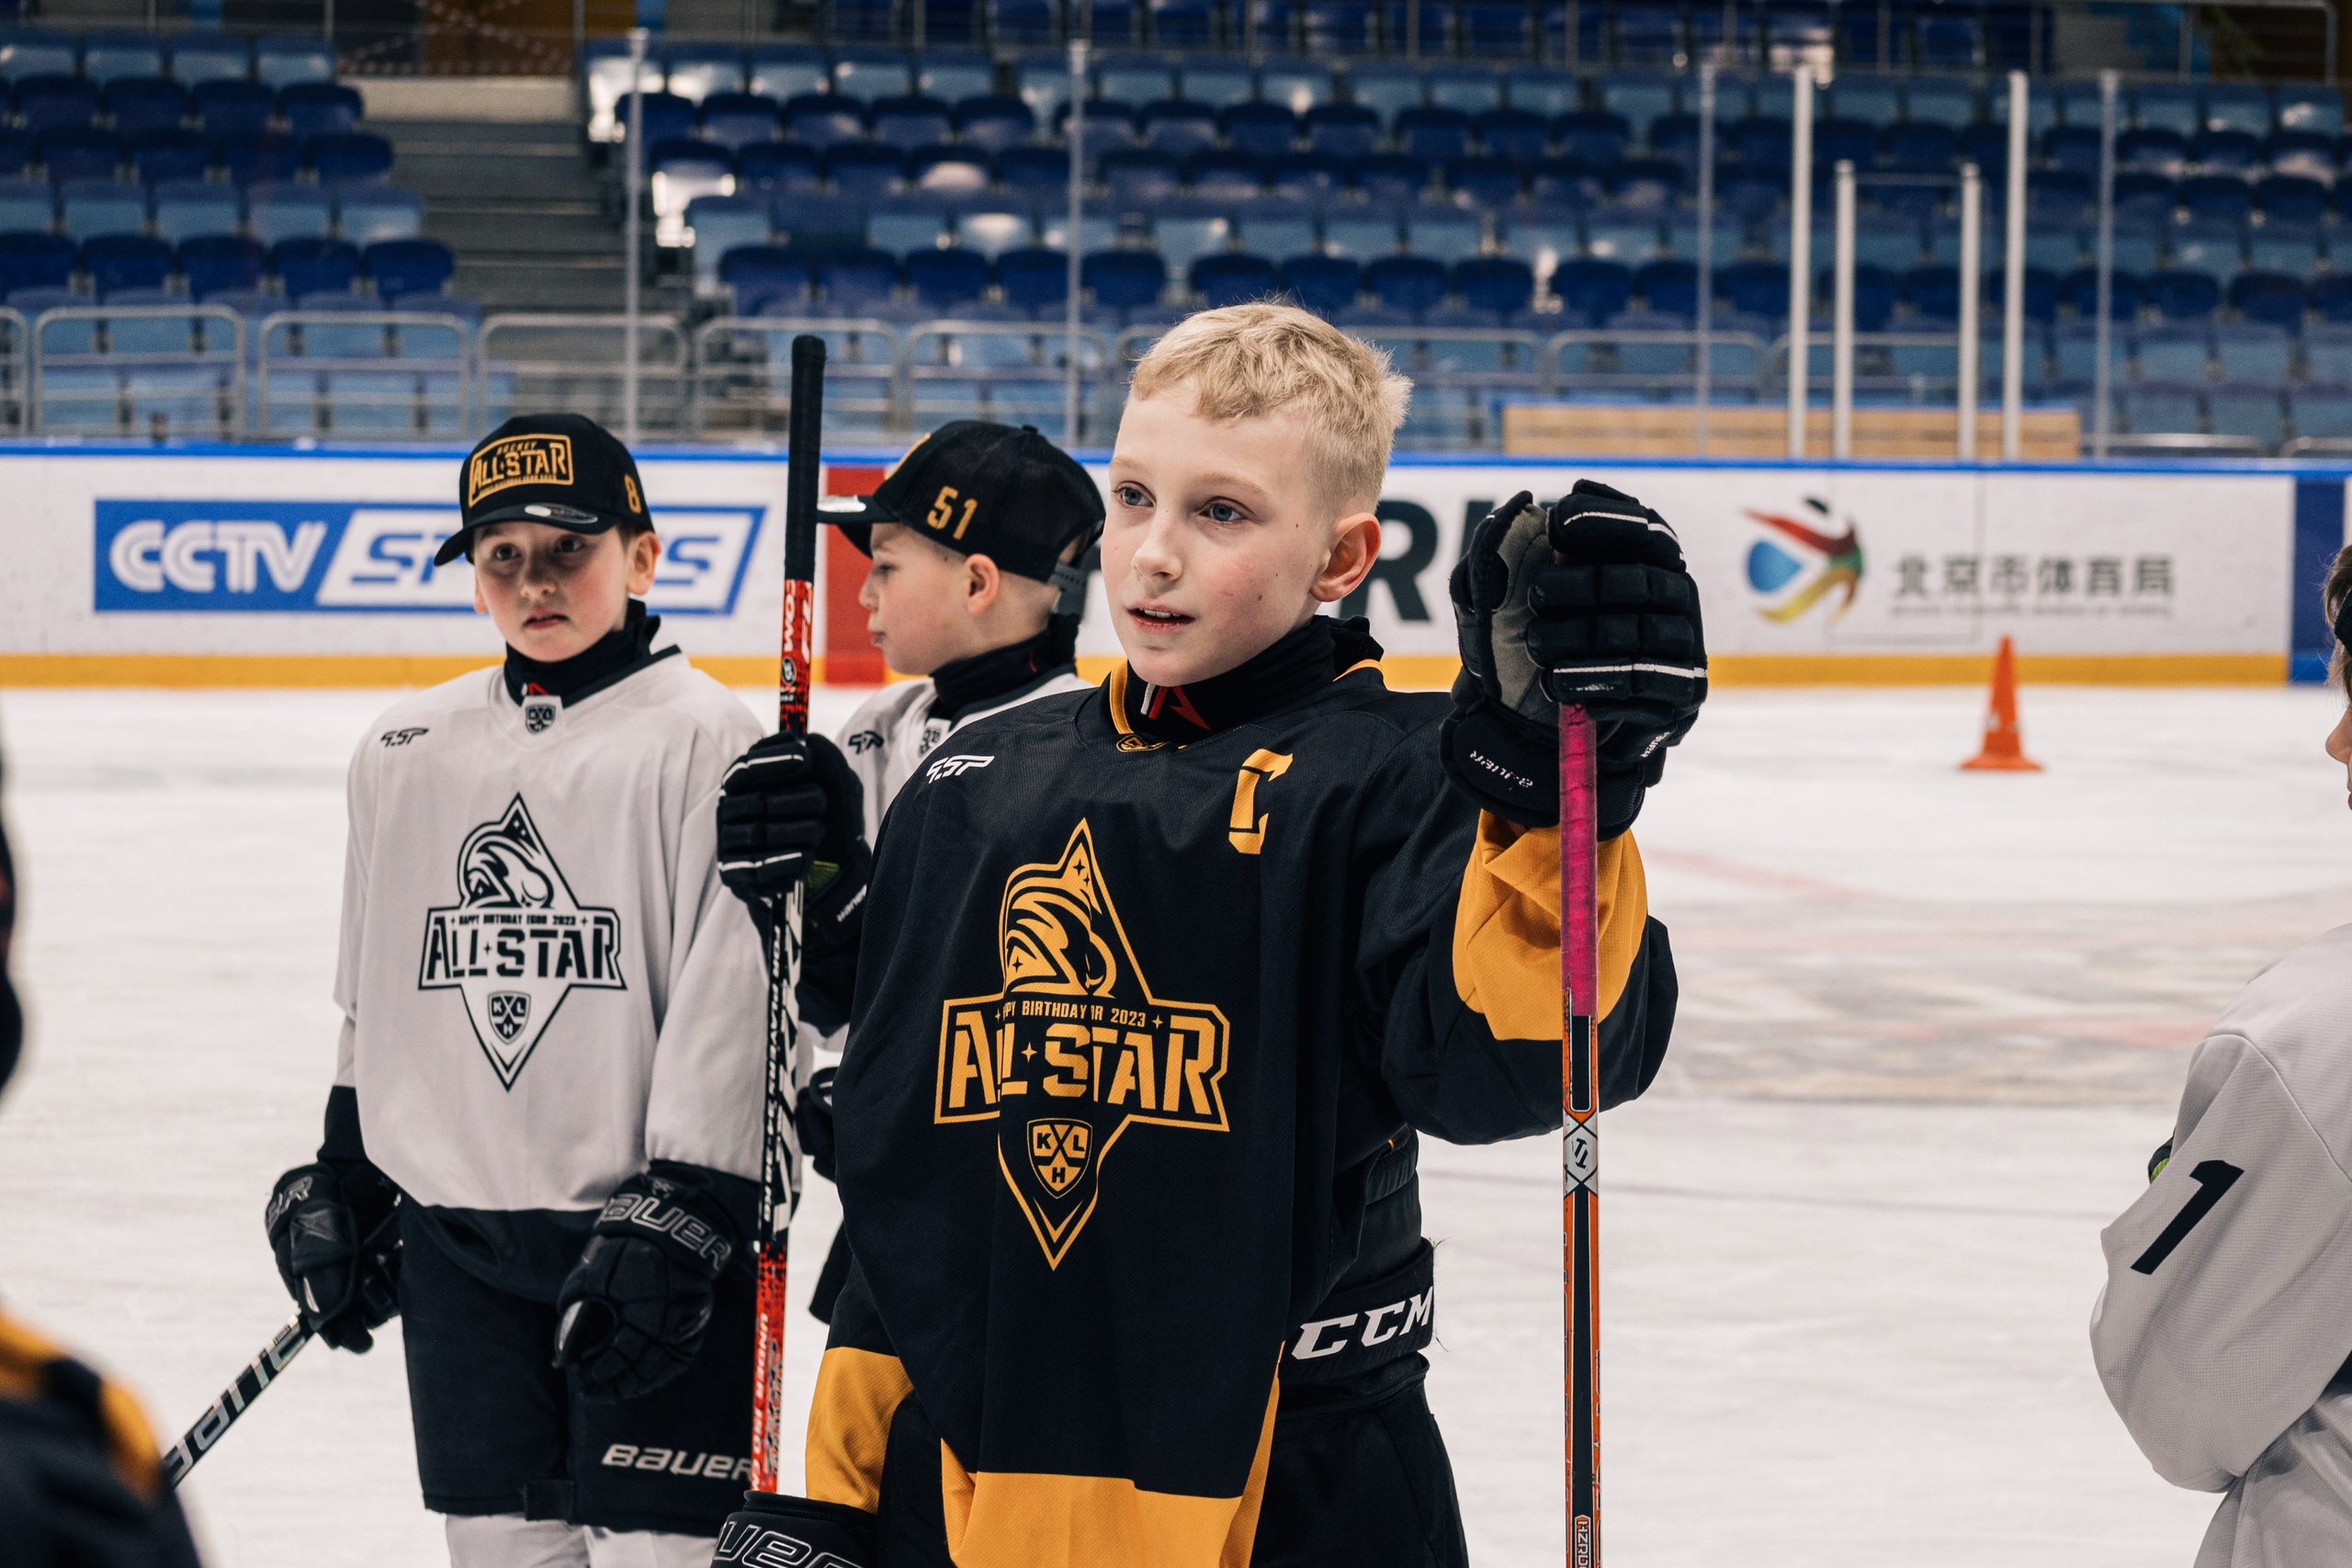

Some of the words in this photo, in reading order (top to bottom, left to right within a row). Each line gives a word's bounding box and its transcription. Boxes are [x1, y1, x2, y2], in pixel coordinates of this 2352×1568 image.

[624, 474, 641, 514] 8
[926, 485, 978, 540] 51
[109, 519, 328, 592] CCTV
[1229, 749, 1294, 854] C
[1022, 999, 1087, 1020] BIRTHDAY
[1110, 1008, 1147, 1028] 2023
[602, 1193, 732, 1271] AUER
[2130, 1160, 2245, 1275] 1
[1291, 1286, 1433, 1360] CCM
[1577, 1520, 1589, 1568] HZRD
